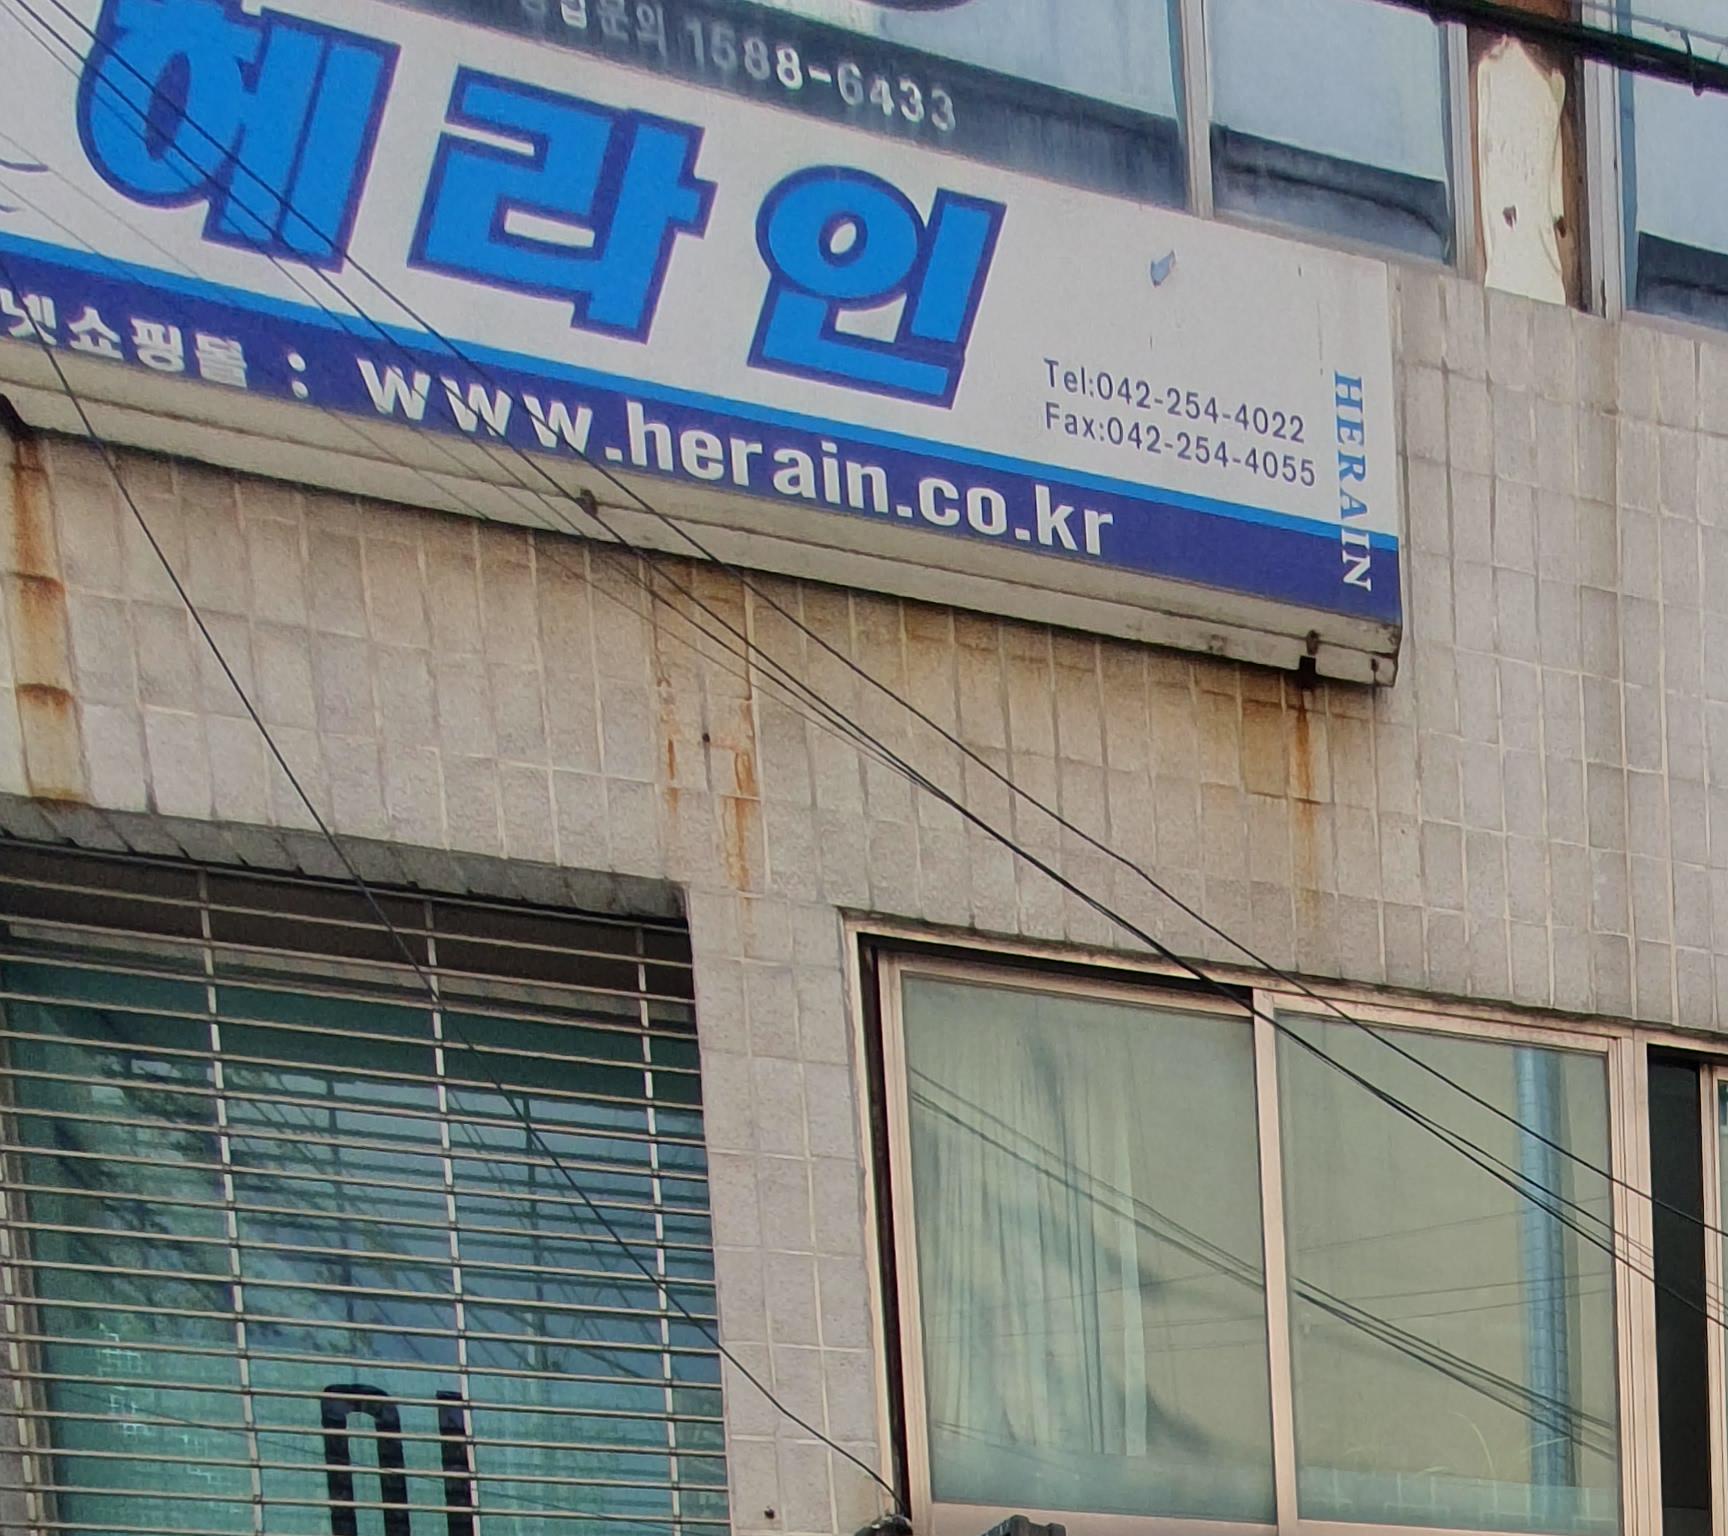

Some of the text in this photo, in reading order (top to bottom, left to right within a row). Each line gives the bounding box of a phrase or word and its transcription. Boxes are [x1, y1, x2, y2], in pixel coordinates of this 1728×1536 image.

[75, 0, 1007, 411] 헤라인
[356, 355, 1114, 556] www.herain.co.kr
[1043, 358, 1306, 445] Tel:042-254-4022
[1043, 402, 1318, 488] Fax:042-254-4055
[1334, 370, 1372, 592] HERAIN
